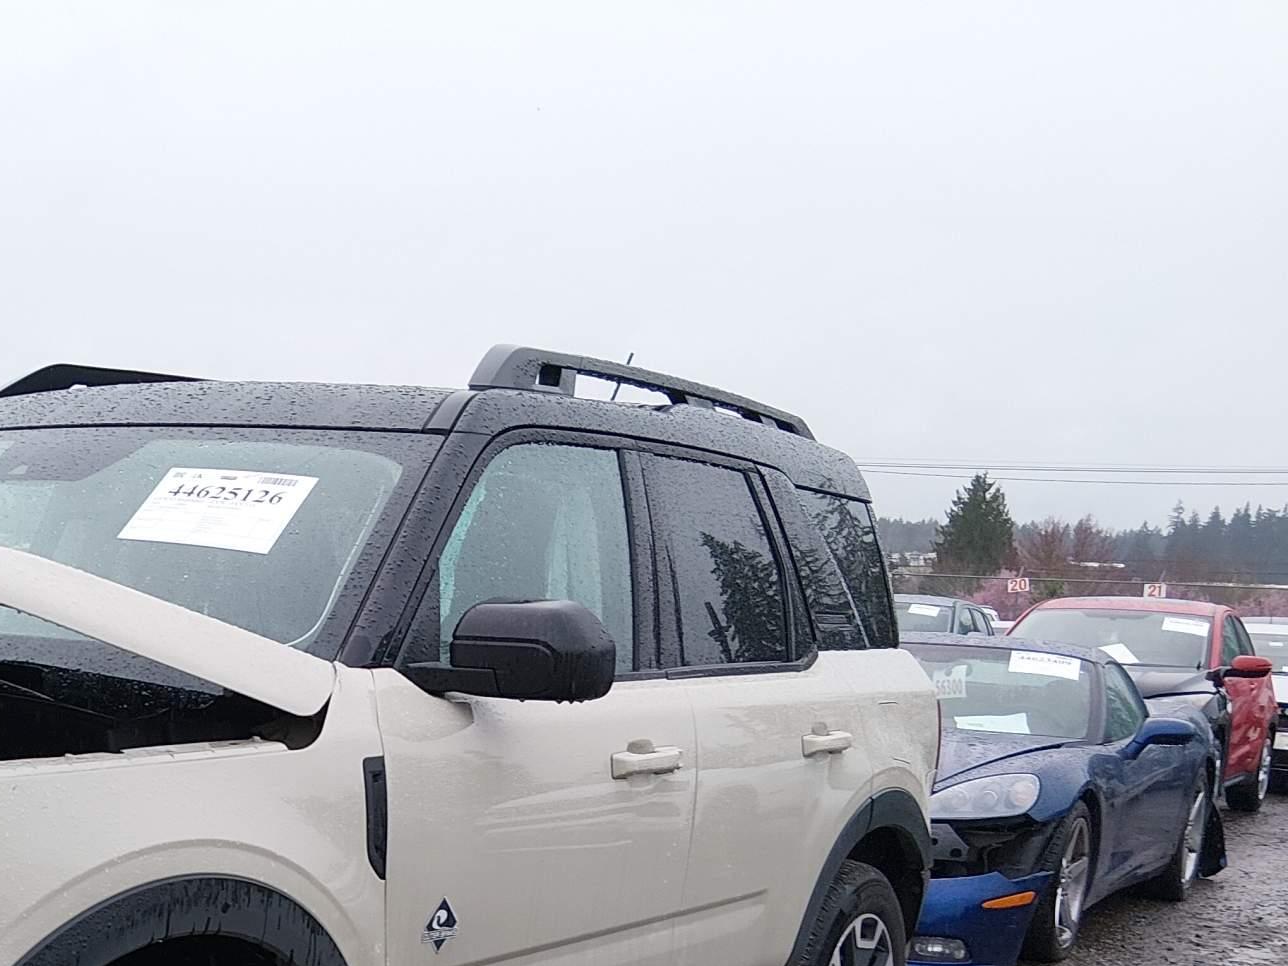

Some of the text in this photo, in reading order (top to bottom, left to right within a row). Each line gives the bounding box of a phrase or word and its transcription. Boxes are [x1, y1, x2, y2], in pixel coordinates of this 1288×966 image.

[168, 483, 285, 506] 44625126
[1010, 579, 1027, 592] 20
[1148, 584, 1162, 597] 21
